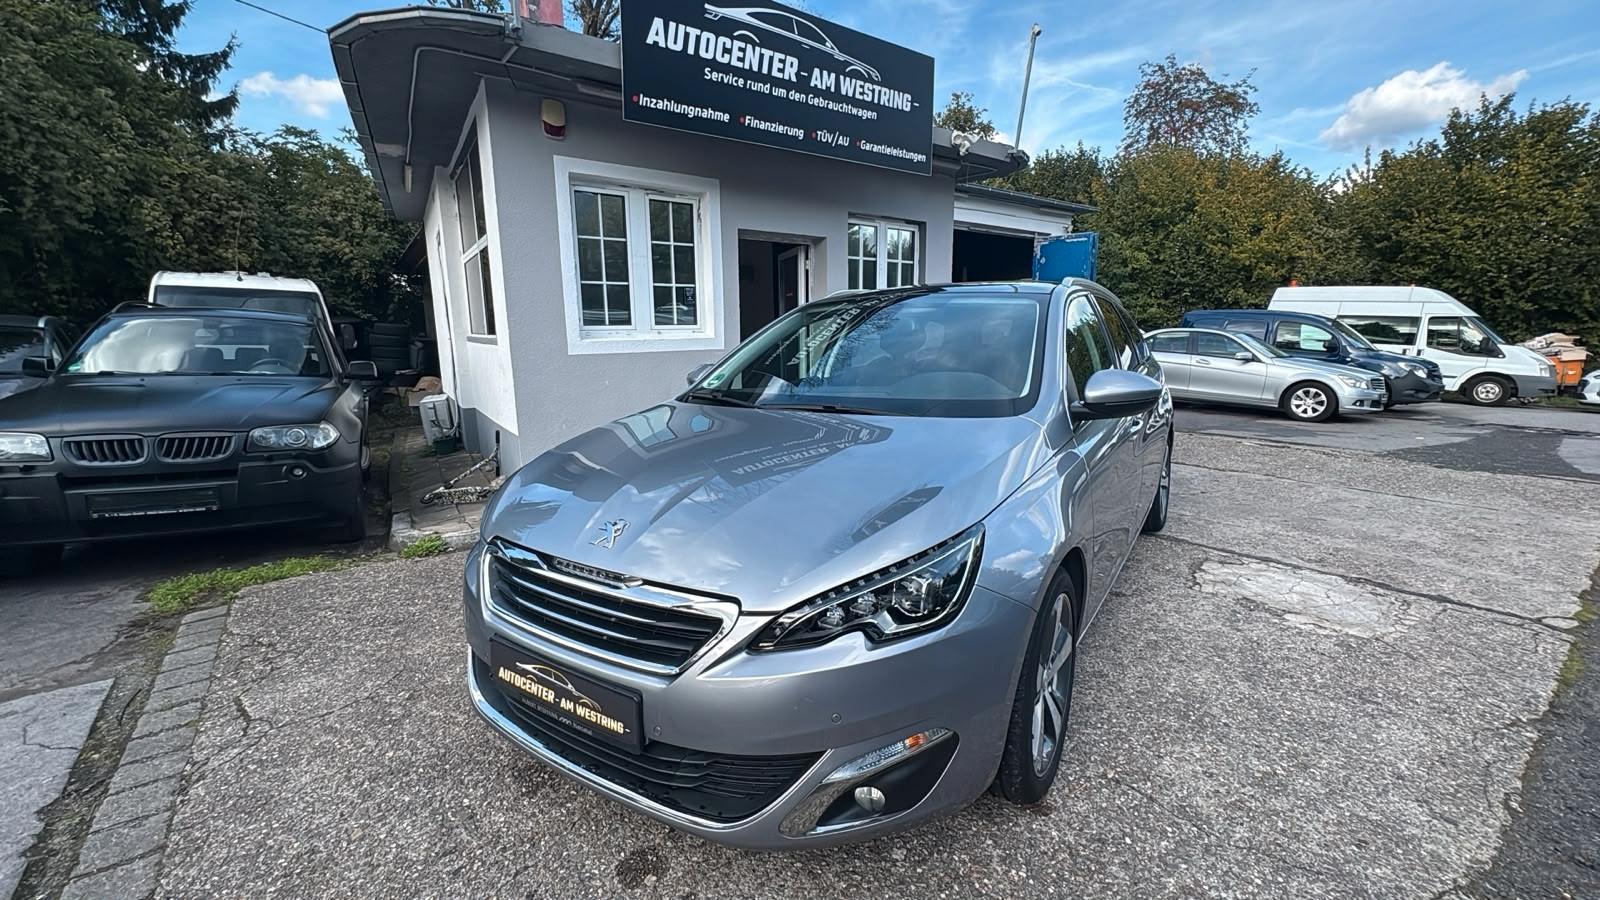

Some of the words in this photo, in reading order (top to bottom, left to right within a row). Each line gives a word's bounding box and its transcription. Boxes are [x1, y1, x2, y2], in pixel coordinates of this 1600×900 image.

[646, 16, 799, 82] AUTOCENTER
[810, 67, 836, 93] AM
[839, 75, 912, 112] WESTRING
[639, 93, 730, 123] Inzahlungnahme
[704, 67, 745, 88] Service
[746, 80, 771, 94] rund
[772, 87, 787, 98] um
[788, 89, 806, 103] den
[807, 94, 877, 120] Gebrauchtwagen
[744, 115, 804, 140] Finanzierung
[816, 130, 850, 147] TÜV/AU
[860, 140, 926, 163] Garantieleistungen
[498, 666, 555, 704] AUTOCENTER
[560, 697, 574, 713] AM
[575, 703, 625, 735] WESTRING
